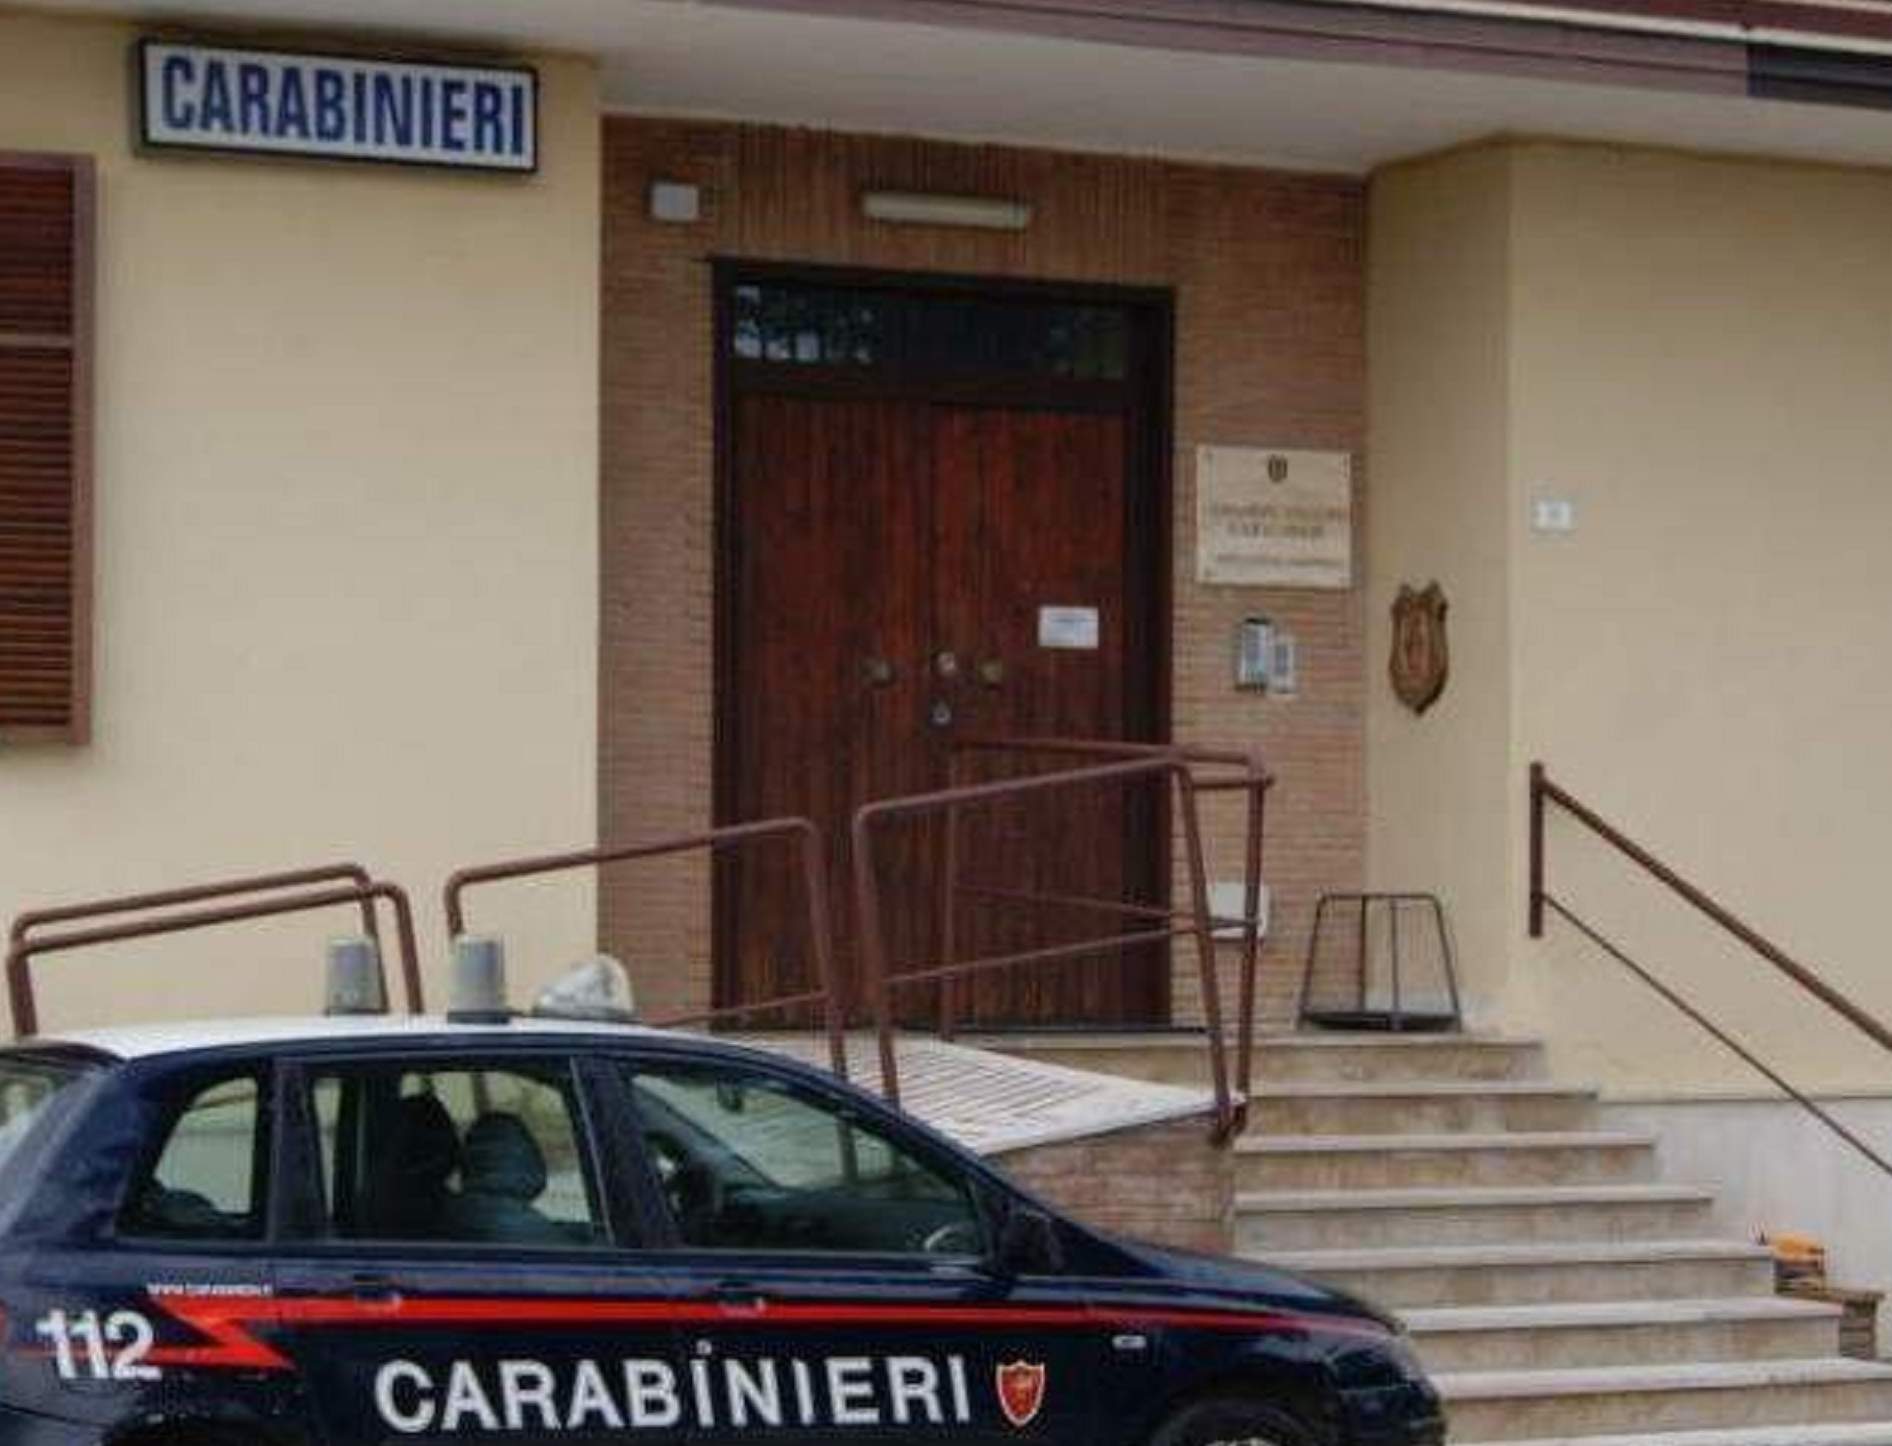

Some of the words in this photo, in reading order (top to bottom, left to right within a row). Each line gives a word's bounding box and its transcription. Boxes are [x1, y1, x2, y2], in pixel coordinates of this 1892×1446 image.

[161, 55, 524, 155] CARABINIERI
[36, 1309, 162, 1379] 112
[374, 1355, 970, 1433] CARABINIERI
